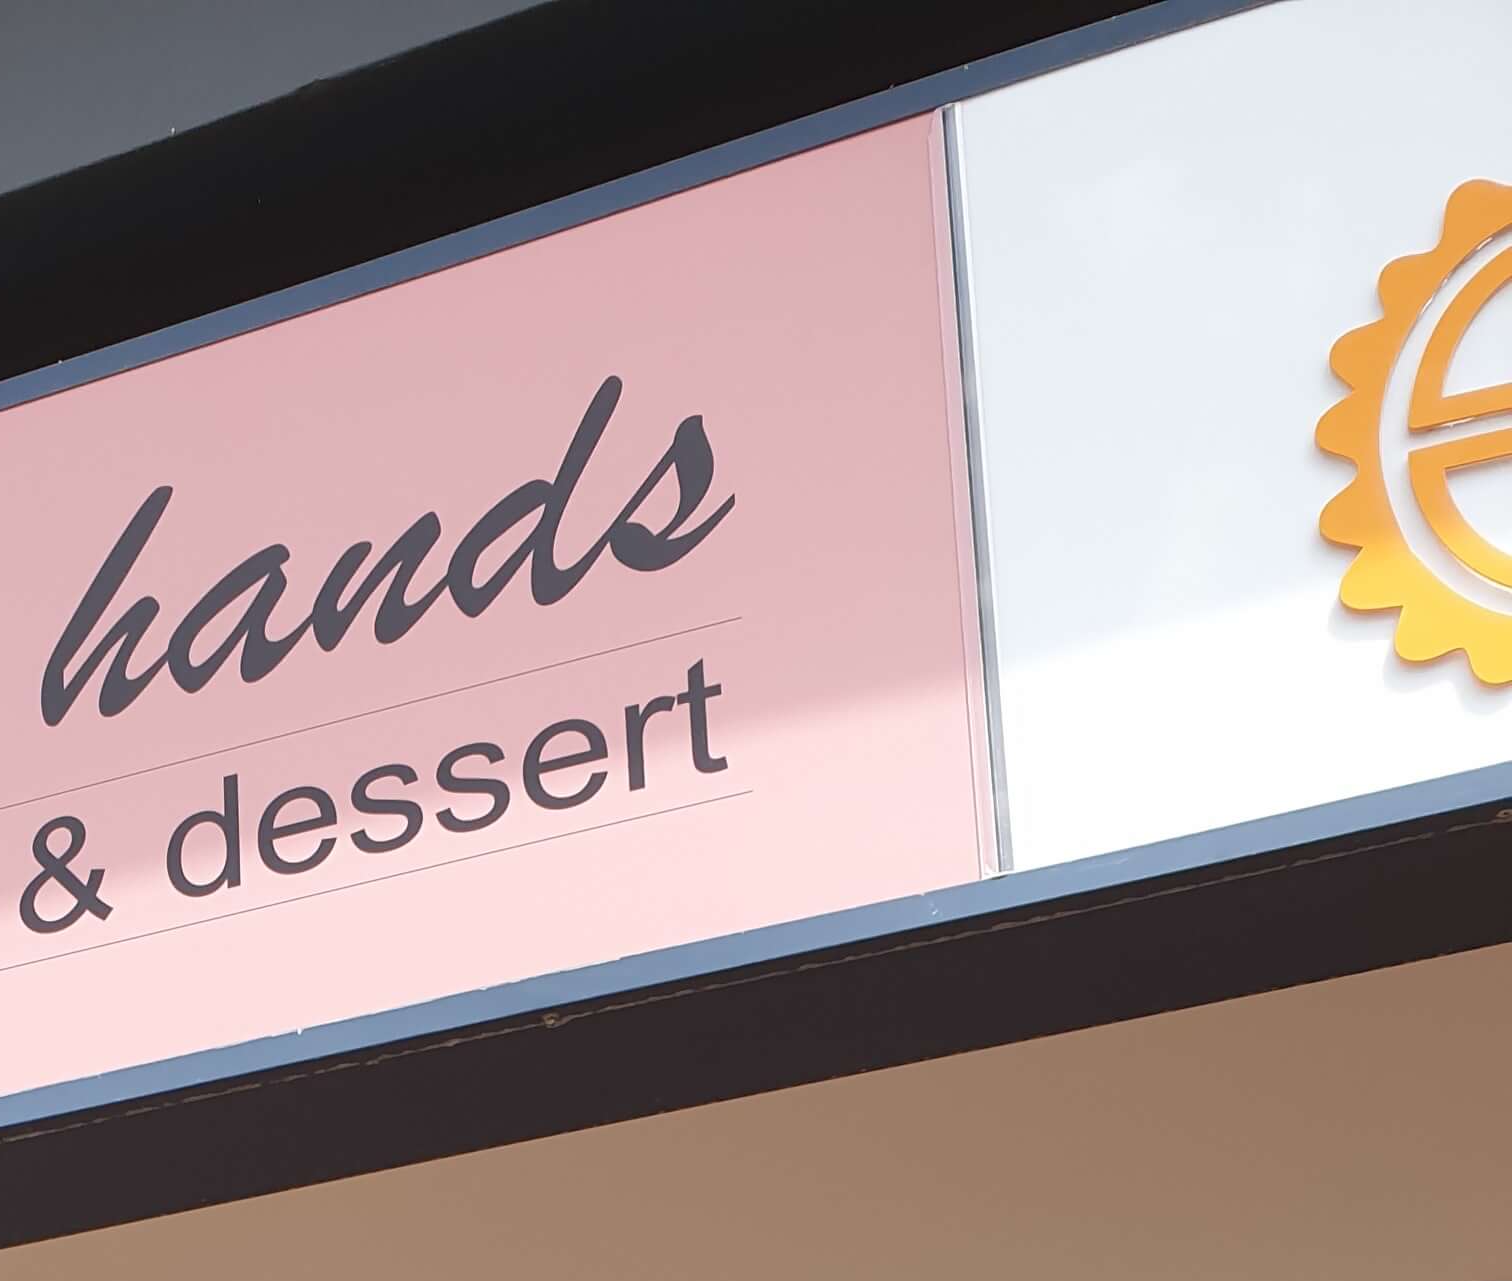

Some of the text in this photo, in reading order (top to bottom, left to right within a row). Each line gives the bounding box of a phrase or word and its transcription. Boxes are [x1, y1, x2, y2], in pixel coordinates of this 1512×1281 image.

[41, 376, 735, 726] hands
[20, 816, 112, 933] &
[167, 659, 727, 896] dessert
